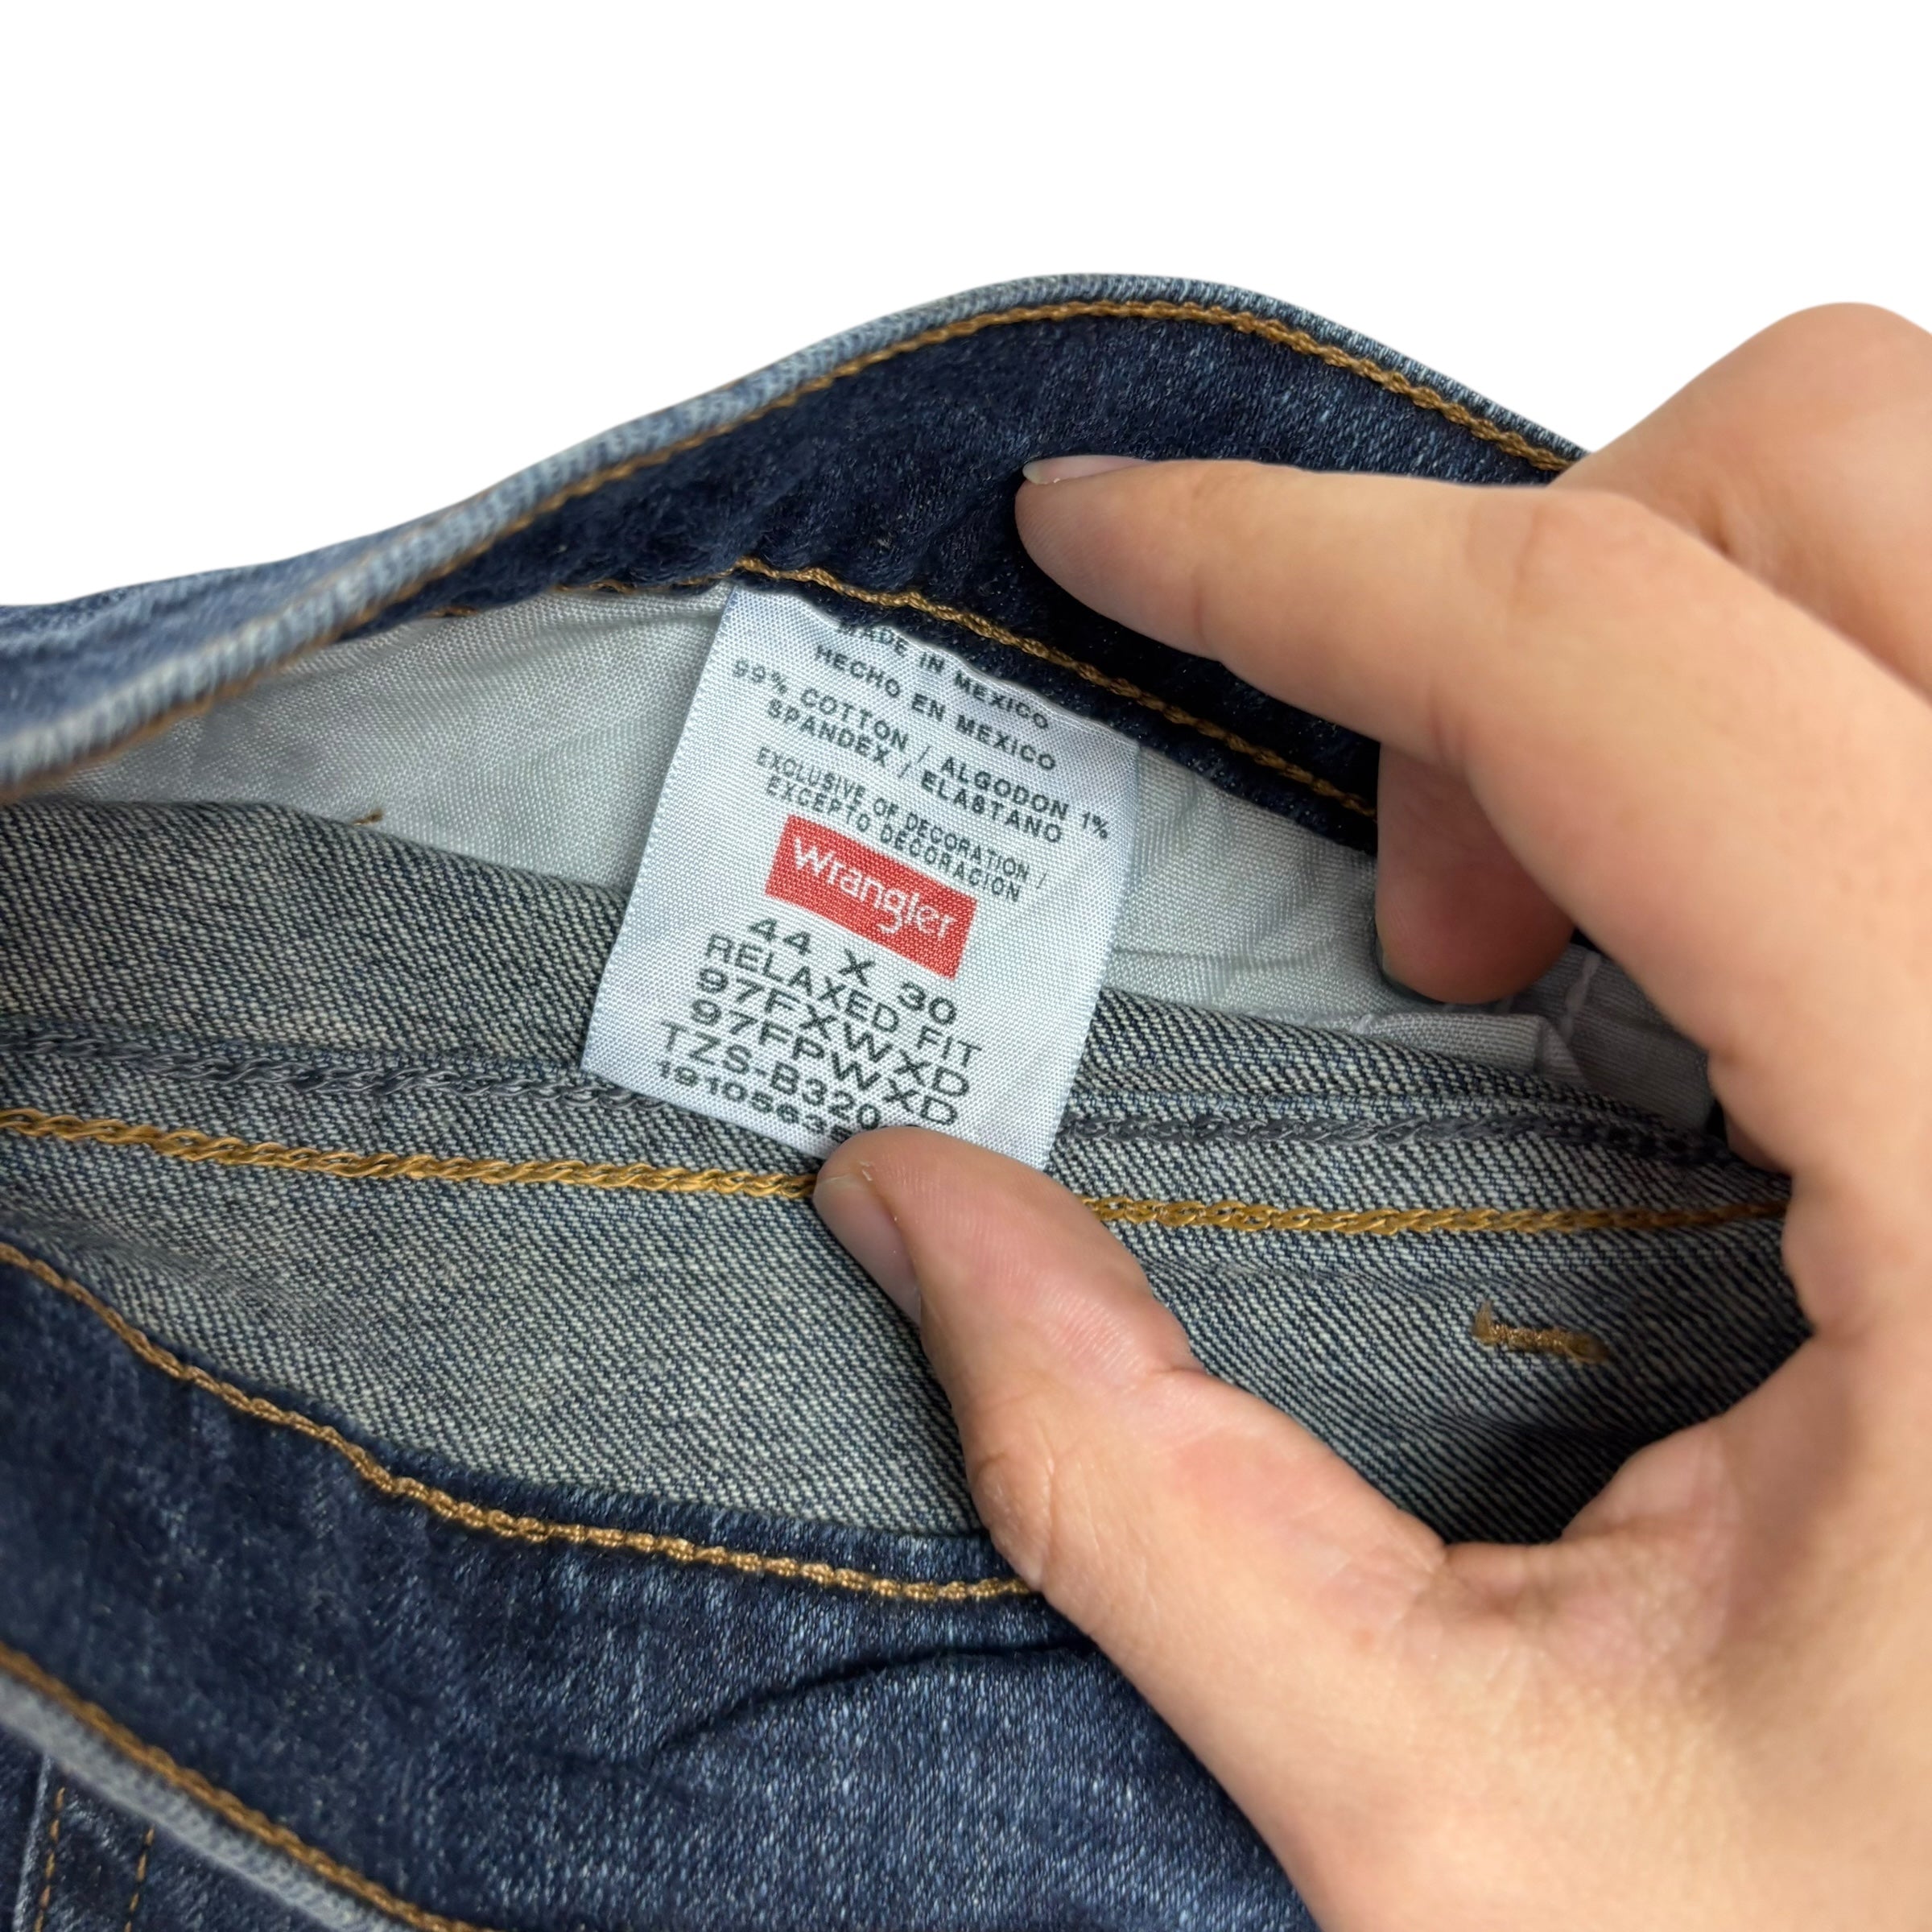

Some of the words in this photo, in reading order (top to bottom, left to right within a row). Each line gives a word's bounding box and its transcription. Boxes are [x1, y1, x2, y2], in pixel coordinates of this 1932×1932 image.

[732, 658, 788, 695] 99%
[800, 687, 909, 753] COTTON
[917, 745, 931, 764] /
[940, 756, 1069, 820] ALGODON
[1080, 811, 1108, 840] 1%
[815, 644, 901, 698] HECHO
[911, 692, 946, 722] EN
[955, 714, 1056, 770] MEXICO
[919, 651, 945, 674] IN
[954, 671, 1049, 729] MEXICO
[756, 745, 866, 805] EXCLUSIVE
[873, 796, 899, 819] OF
[906, 811, 1030, 883] DECORATION
[1035, 873, 1047, 890] /
[767, 698, 890, 769] SPANDEX
[898, 762, 912, 779] /
[920, 769, 1063, 844] ELASTANO
[765, 774, 871, 833] EXCEPTO
[880, 823, 1020, 903] DECORACION
[792, 836, 959, 939] Wrangler
[696, 968, 970, 1097] 97FXWXD
[704, 933, 901, 1034] RELAXED
[917, 1026, 983, 1068] FIT
[748, 917, 812, 956] 44
[838, 948, 876, 987] X
[896, 980, 958, 1026] 30
[660, 1022, 882, 1130] TZS-B320
[689, 997, 959, 1126] 97FPWXD
